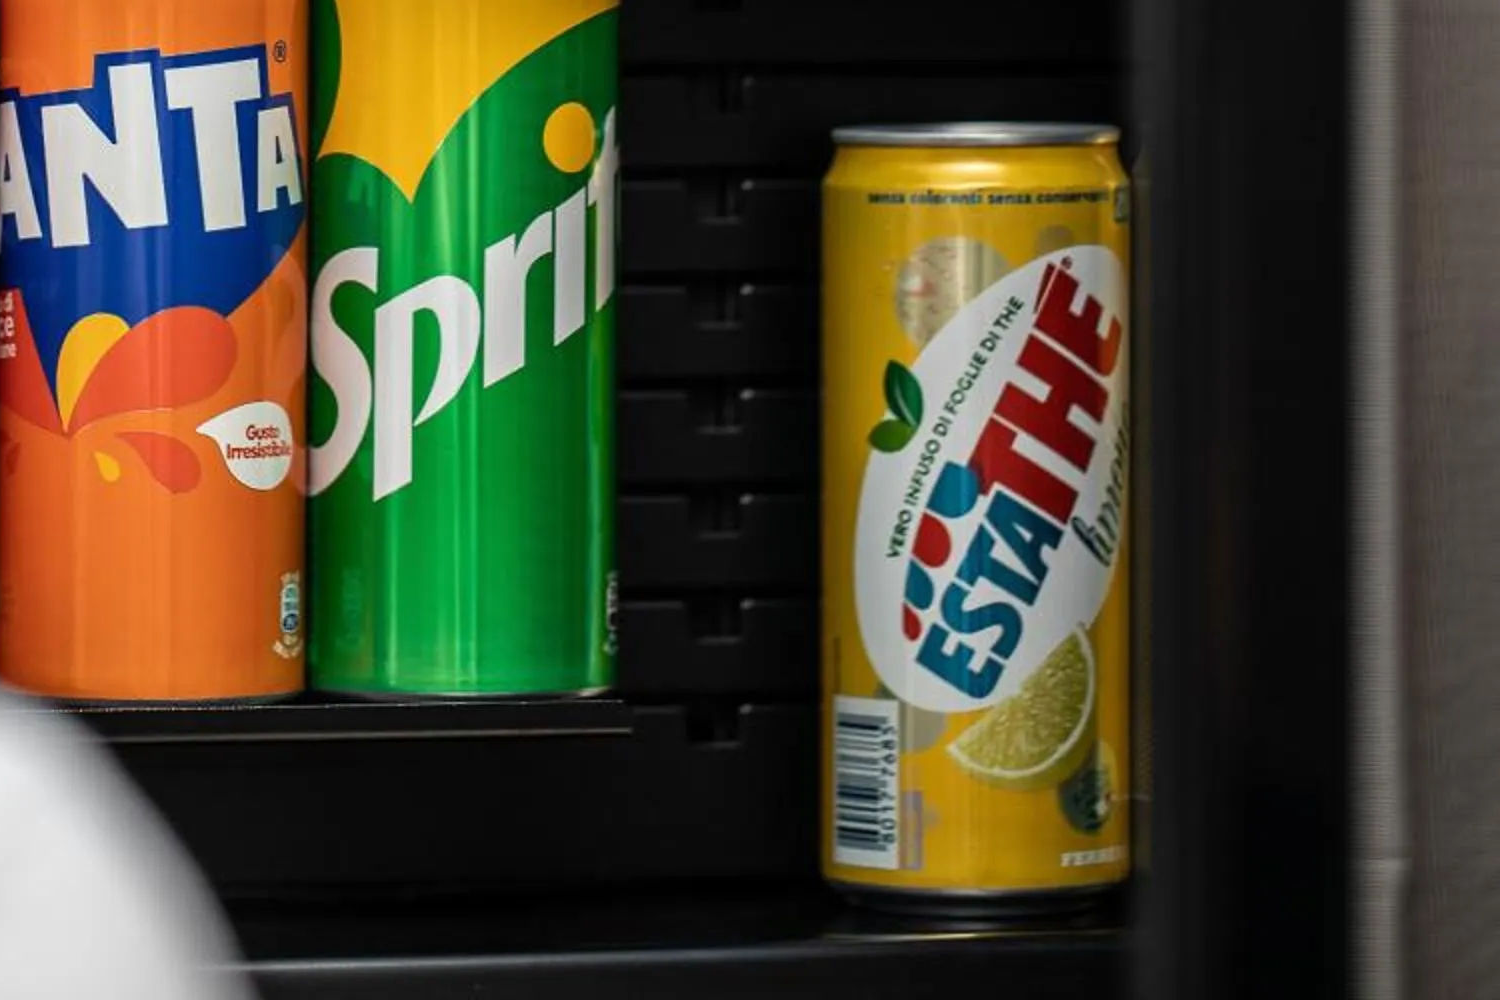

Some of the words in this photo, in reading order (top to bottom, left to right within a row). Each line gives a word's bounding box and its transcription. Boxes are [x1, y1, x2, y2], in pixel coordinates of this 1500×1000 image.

[245, 423, 280, 441] Gusto
[886, 508, 913, 559] VERO
[904, 438, 942, 507] INFUSO
[932, 415, 953, 438] DI
[943, 351, 988, 415] FOGLIE
[979, 331, 1001, 352] DI
[992, 295, 1025, 331] THE
